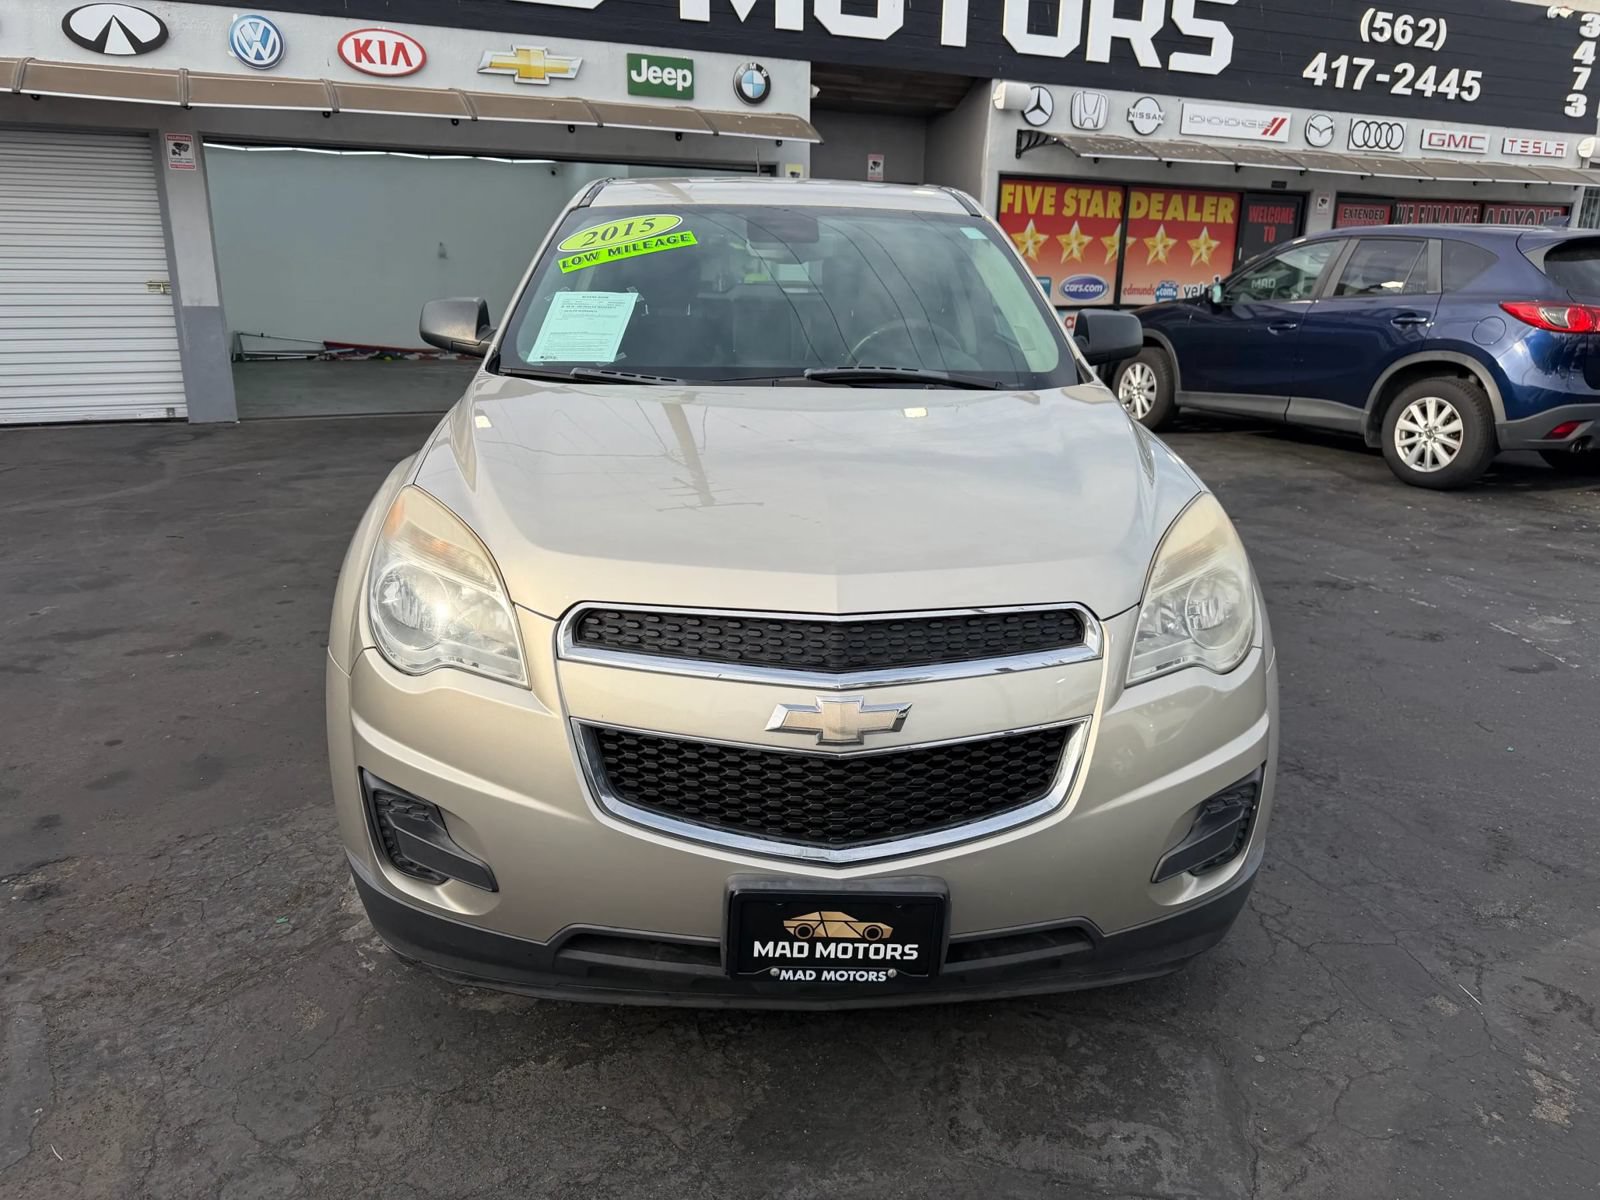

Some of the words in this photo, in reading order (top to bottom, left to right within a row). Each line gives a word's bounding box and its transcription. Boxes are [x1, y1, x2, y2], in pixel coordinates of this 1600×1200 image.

[680, 0, 1234, 75] ORS
[1360, 8, 1447, 51] (562)
[352, 38, 413, 67] KIA
[630, 58, 692, 91] Jeep
[1303, 52, 1483, 102] 417-2445
[1128, 111, 1164, 121] NISSAN
[1188, 114, 1273, 129] DODGE
[1428, 132, 1486, 150] GMC
[1508, 139, 1564, 155] TESLA
[1000, 183, 1056, 216] FIVE
[1062, 186, 1122, 219] STAR
[1128, 191, 1234, 224] DEALER
[1343, 207, 1385, 220] EXTENDED
[1248, 205, 1295, 225] WELCOME
[581, 217, 657, 247] 2015
[1264, 225, 1276, 243] TO
[561, 252, 599, 269] LOW
[607, 232, 692, 257] MILEAGE
[1064, 282, 1104, 293] cars.com
[1183, 282, 1208, 299] yel
[753, 940, 809, 958] MAD
[815, 942, 919, 960] MOTORS
[779, 969, 817, 981] MAD
[821, 970, 887, 982] MOTORS
